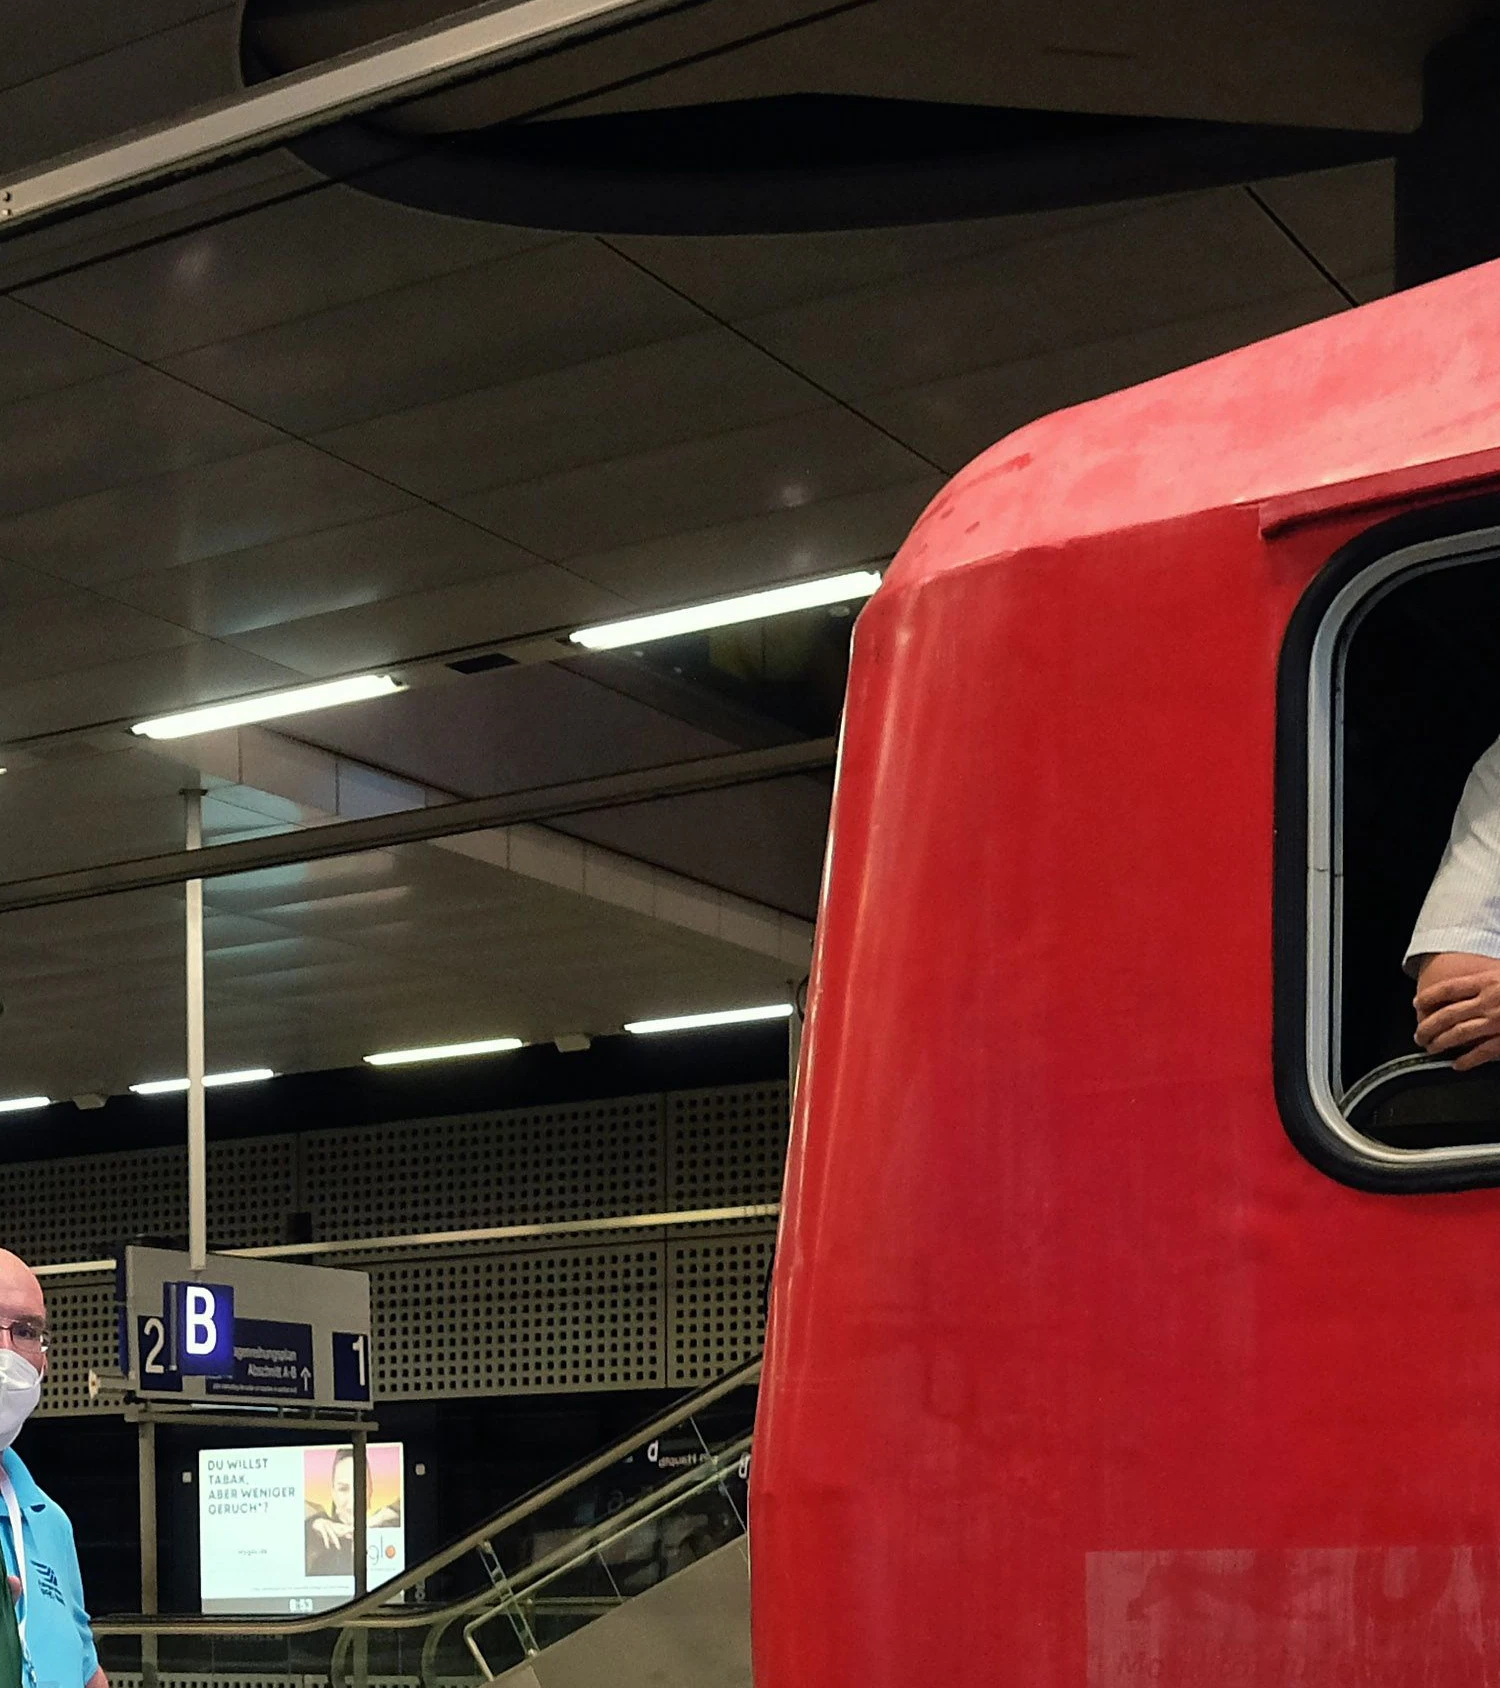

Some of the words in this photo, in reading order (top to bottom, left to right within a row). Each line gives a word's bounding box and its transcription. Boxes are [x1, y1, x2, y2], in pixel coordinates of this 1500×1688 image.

[143, 1318, 165, 1374] 2
[185, 1286, 217, 1355] B
[352, 1335, 366, 1386] 1
[208, 1459, 224, 1471] DU
[227, 1458, 268, 1470] WILLST
[208, 1489, 238, 1499] ABER
[241, 1487, 295, 1499] WENIGER
